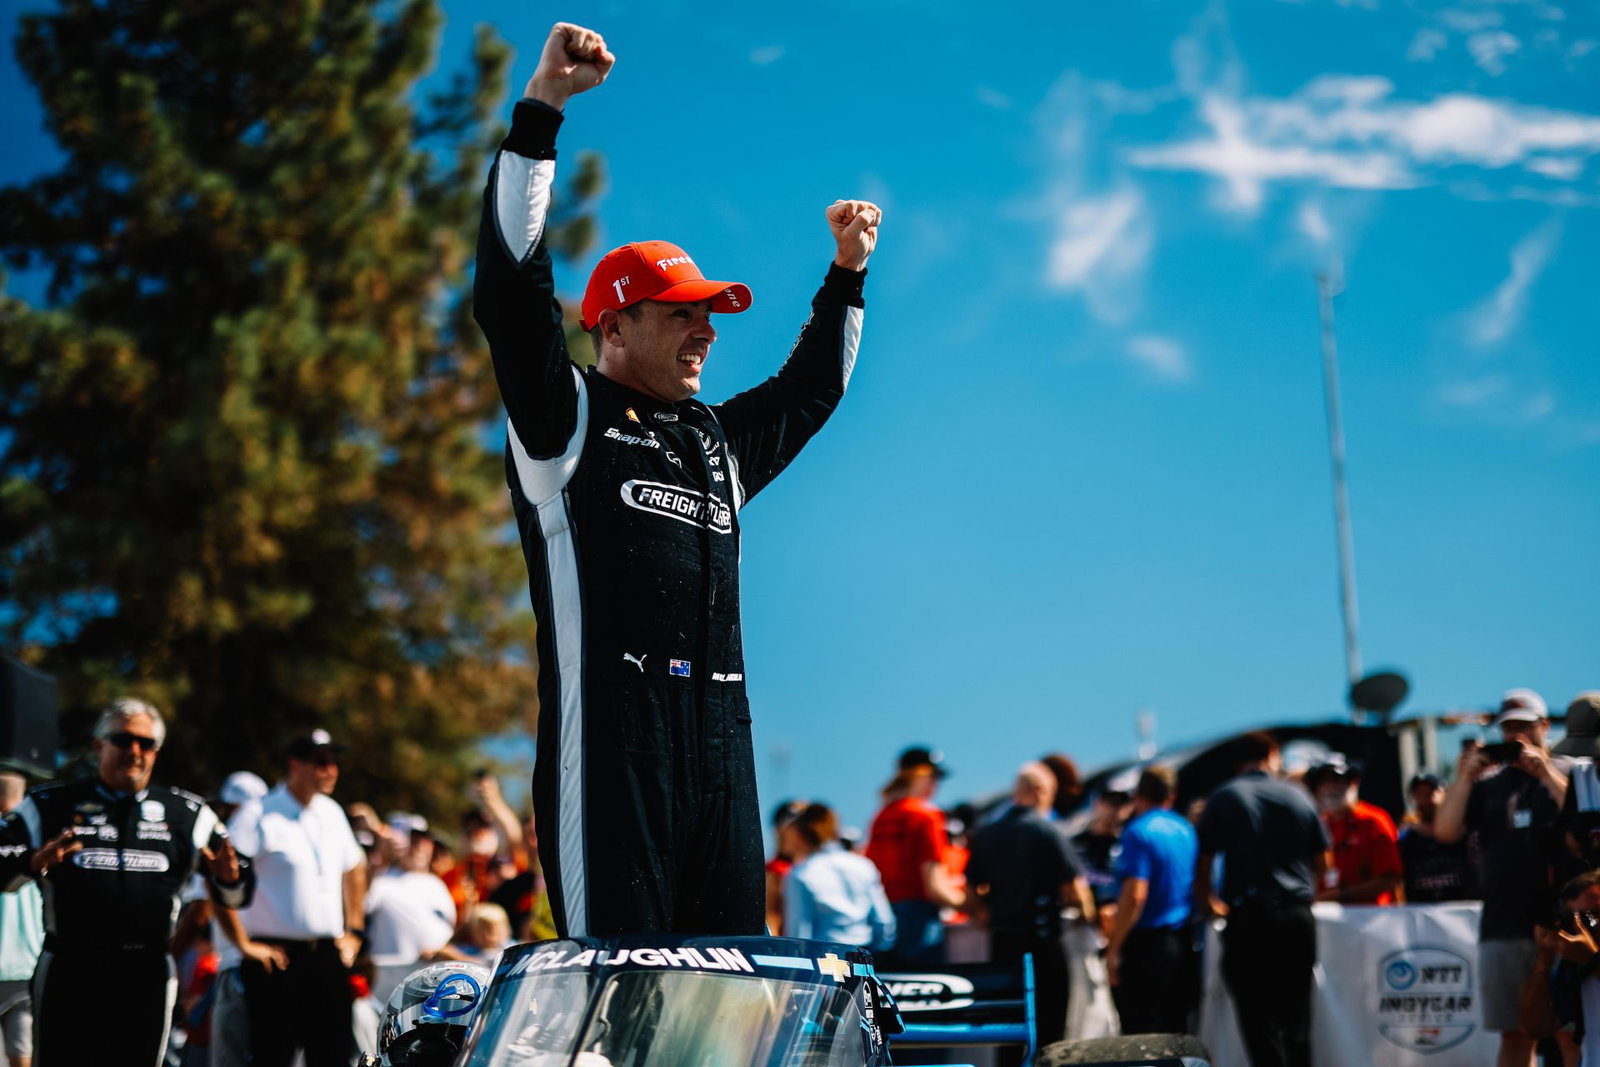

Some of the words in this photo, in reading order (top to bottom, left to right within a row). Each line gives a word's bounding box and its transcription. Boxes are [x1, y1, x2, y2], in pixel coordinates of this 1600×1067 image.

[604, 427, 660, 449] Snap-on
[506, 947, 755, 977] MCLAUGHLIN
[1421, 966, 1462, 983] NTT
[1379, 996, 1472, 1013] INDYCAR
